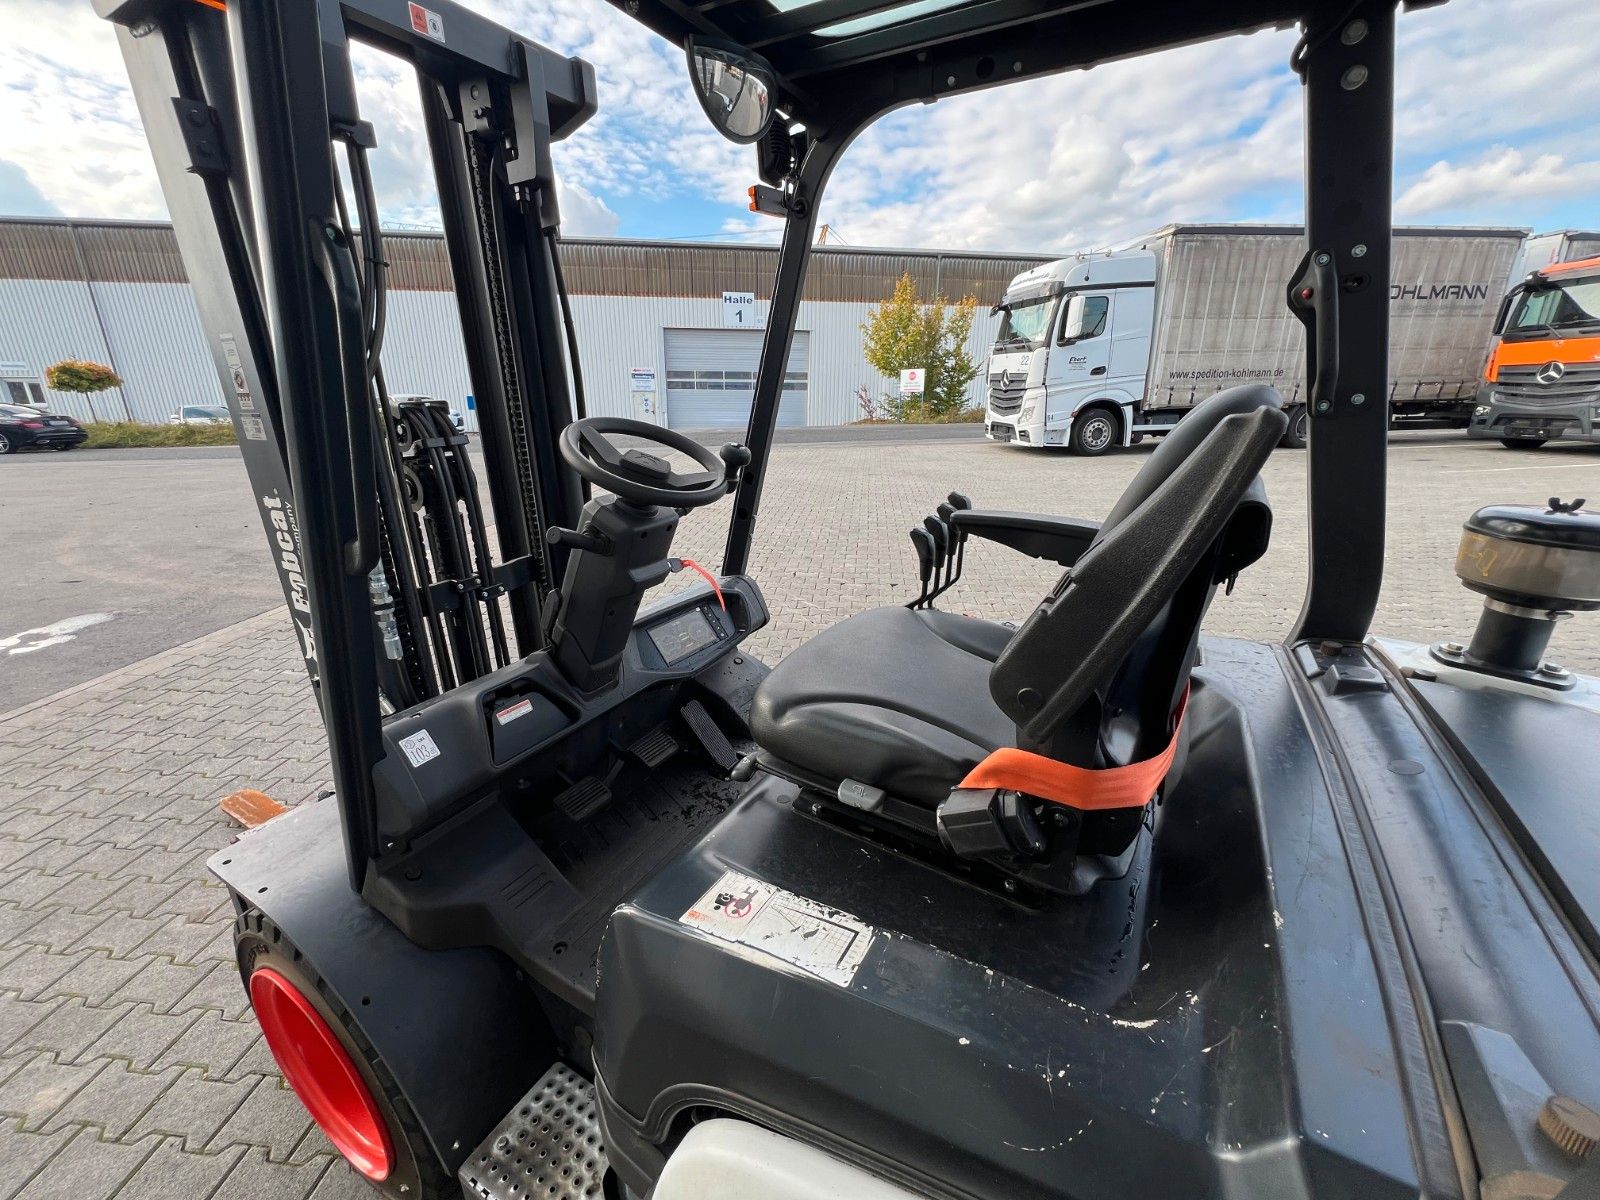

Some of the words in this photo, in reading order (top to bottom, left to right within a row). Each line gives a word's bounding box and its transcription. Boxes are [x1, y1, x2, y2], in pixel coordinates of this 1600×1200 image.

[723, 295, 753, 305] Halle
[735, 309, 743, 323] 1
[1020, 355, 1030, 366] 22
[1169, 368, 1284, 380] www.spedition-kohlmann.de
[284, 501, 301, 556] mpany
[263, 495, 311, 614] Bobcat
[410, 744, 431, 763] 103
